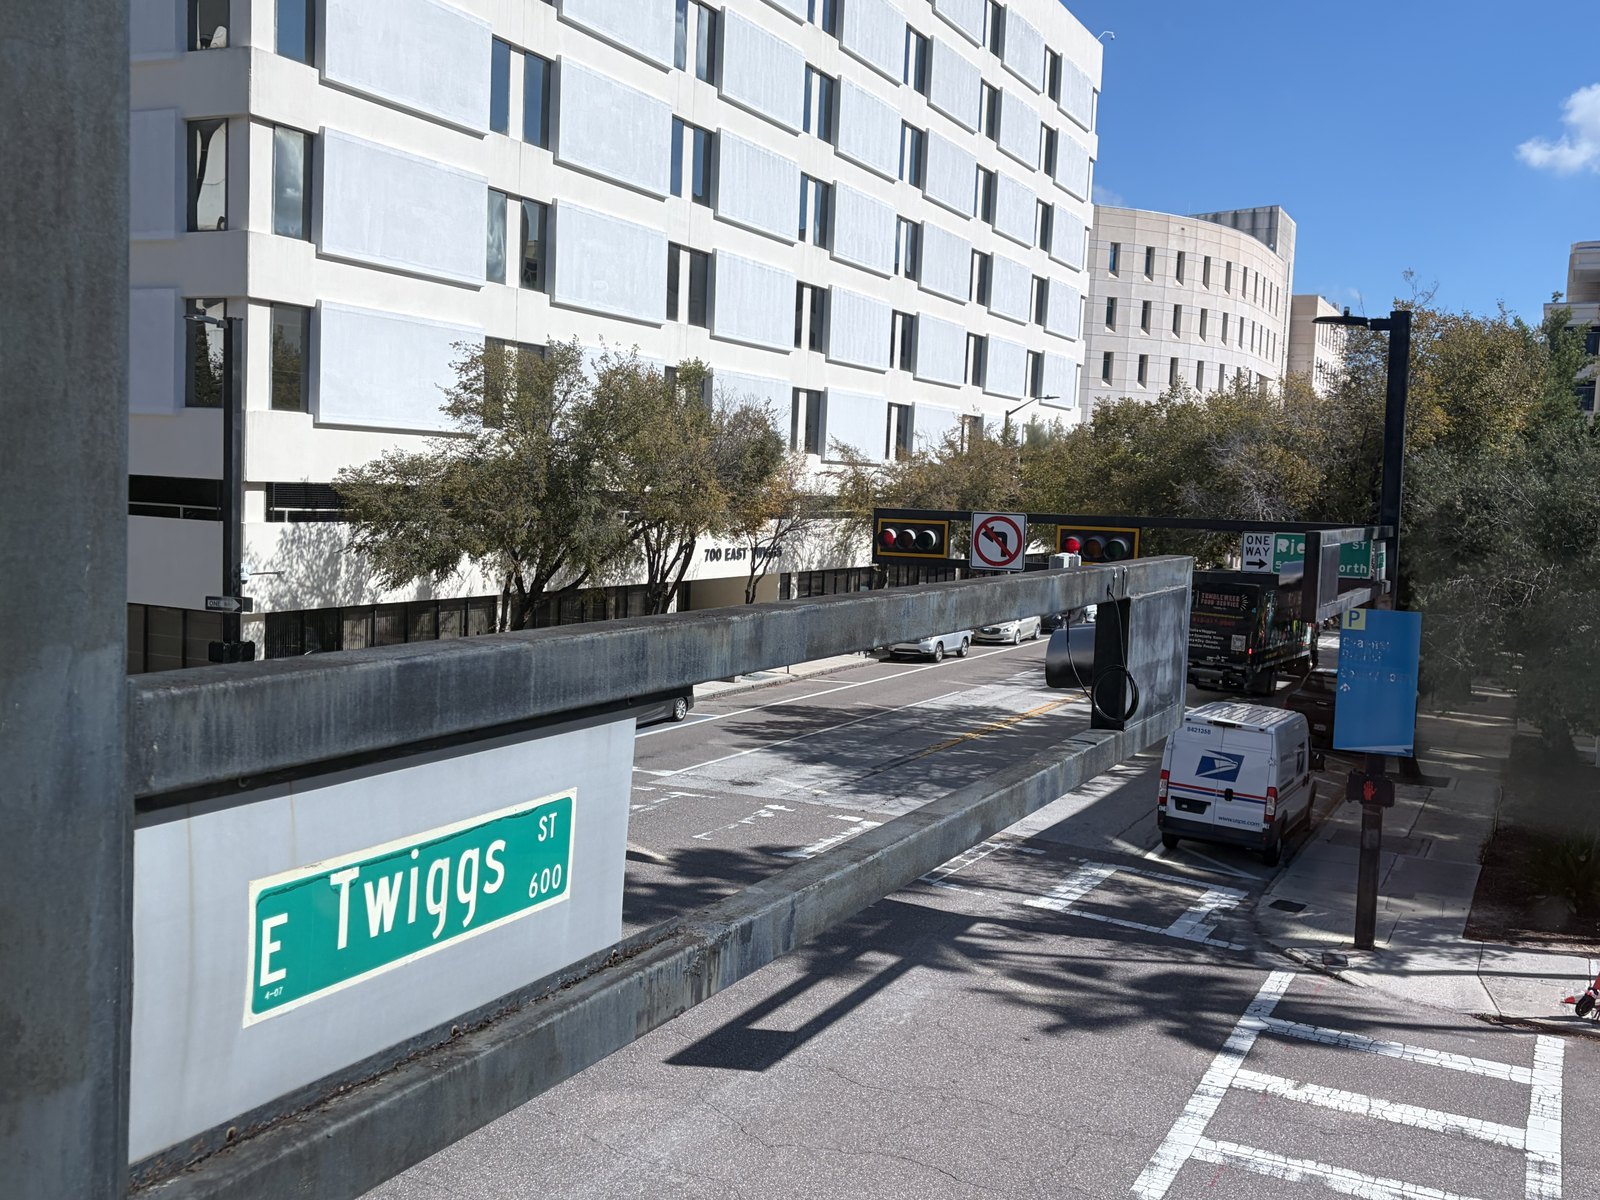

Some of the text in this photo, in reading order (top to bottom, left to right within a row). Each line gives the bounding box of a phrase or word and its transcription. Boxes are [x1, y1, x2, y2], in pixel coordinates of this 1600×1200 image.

[1246, 535, 1270, 545] ONE
[1352, 541, 1367, 550] ST
[704, 548, 722, 562] 700
[724, 547, 747, 561] EAST
[1246, 547, 1270, 556] WAY
[1338, 563, 1367, 574] orth
[1348, 610, 1360, 627] P
[538, 812, 558, 842] ST
[528, 863, 562, 899] 600
[260, 839, 507, 987] E Twiggs
[264, 986, 284, 1000] 4-07
